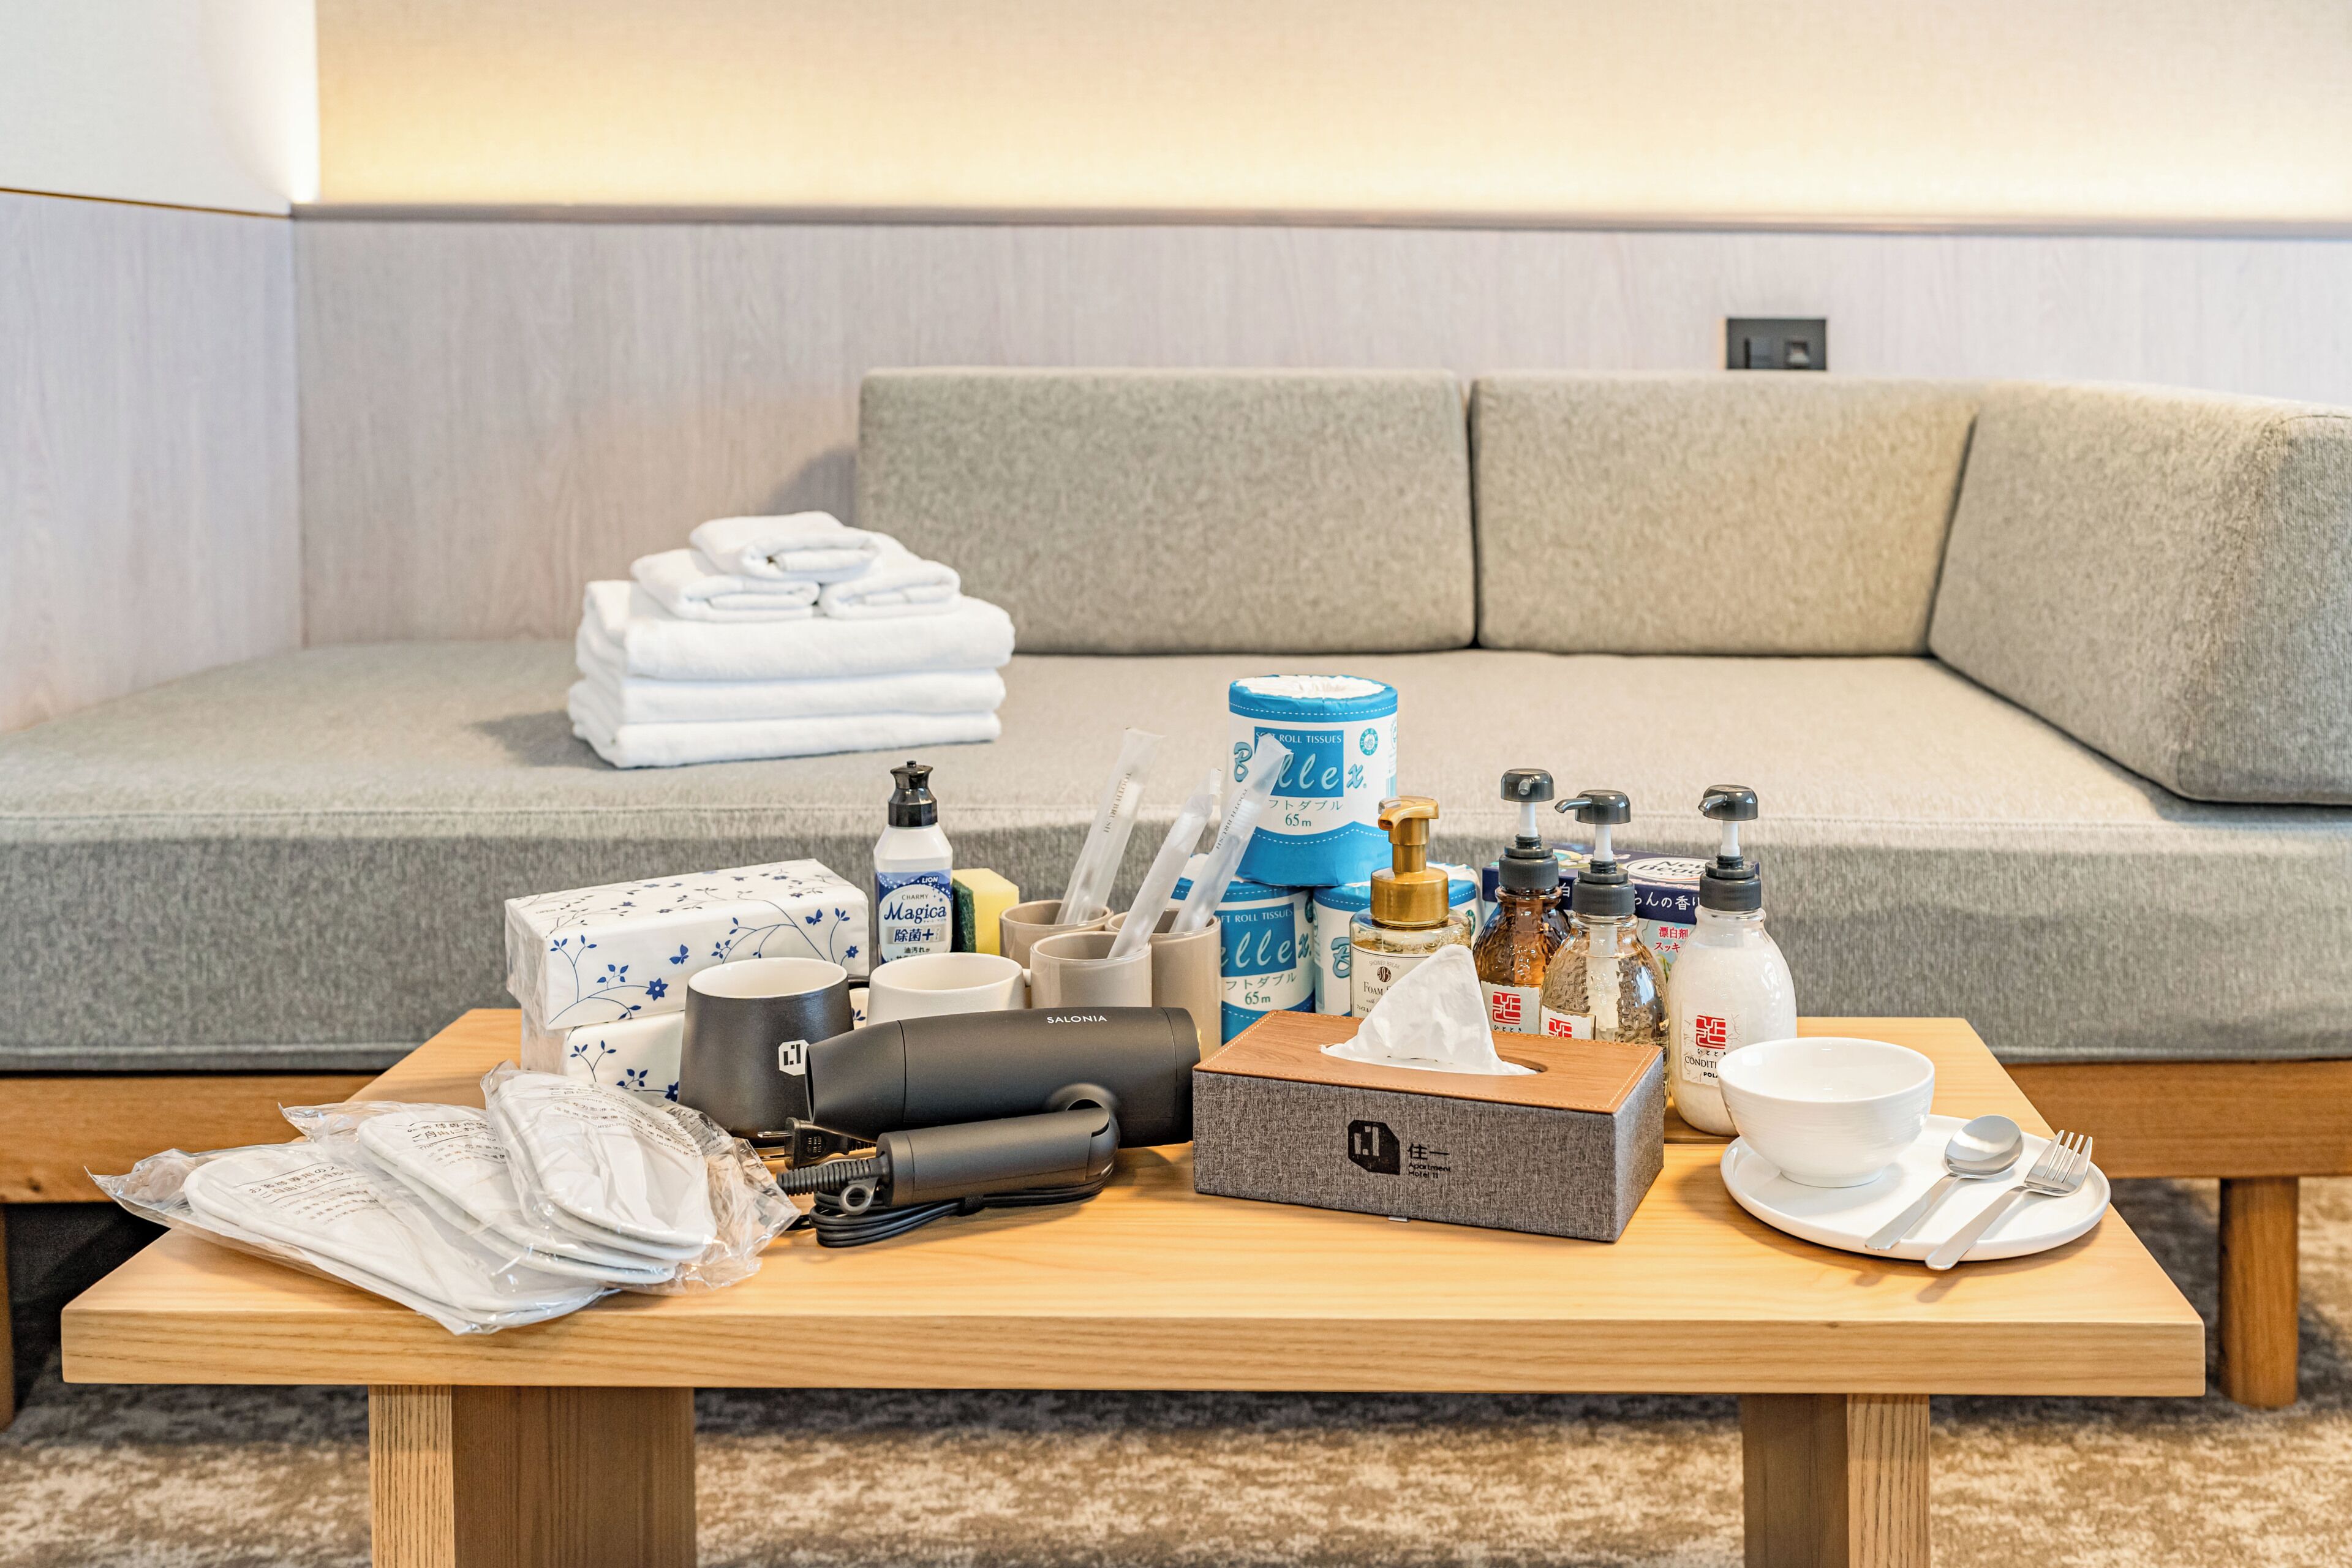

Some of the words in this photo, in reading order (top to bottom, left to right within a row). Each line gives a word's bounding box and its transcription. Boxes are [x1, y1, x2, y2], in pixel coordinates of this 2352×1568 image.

[1279, 734, 1303, 744] ROLL
[1305, 734, 1342, 744] TISSUES
[1234, 741, 1364, 791] Bllex
[1268, 799, 1343, 812] フトダブル
[884, 901, 947, 924] Magica
[1235, 914, 1258, 923] ROLL
[1262, 909, 1294, 921] TISSUES
[1221, 929, 1310, 969] ellex
[1654, 942, 1681, 953] スッキ
[1386, 961, 1401, 970] BREAK
[1226, 972, 1297, 990] フトダブル
[1047, 1015, 1107, 1023] SALONIA
[1684, 1055, 1717, 1069] CONDITI
[1408, 1163, 1451, 1172] Apartment
